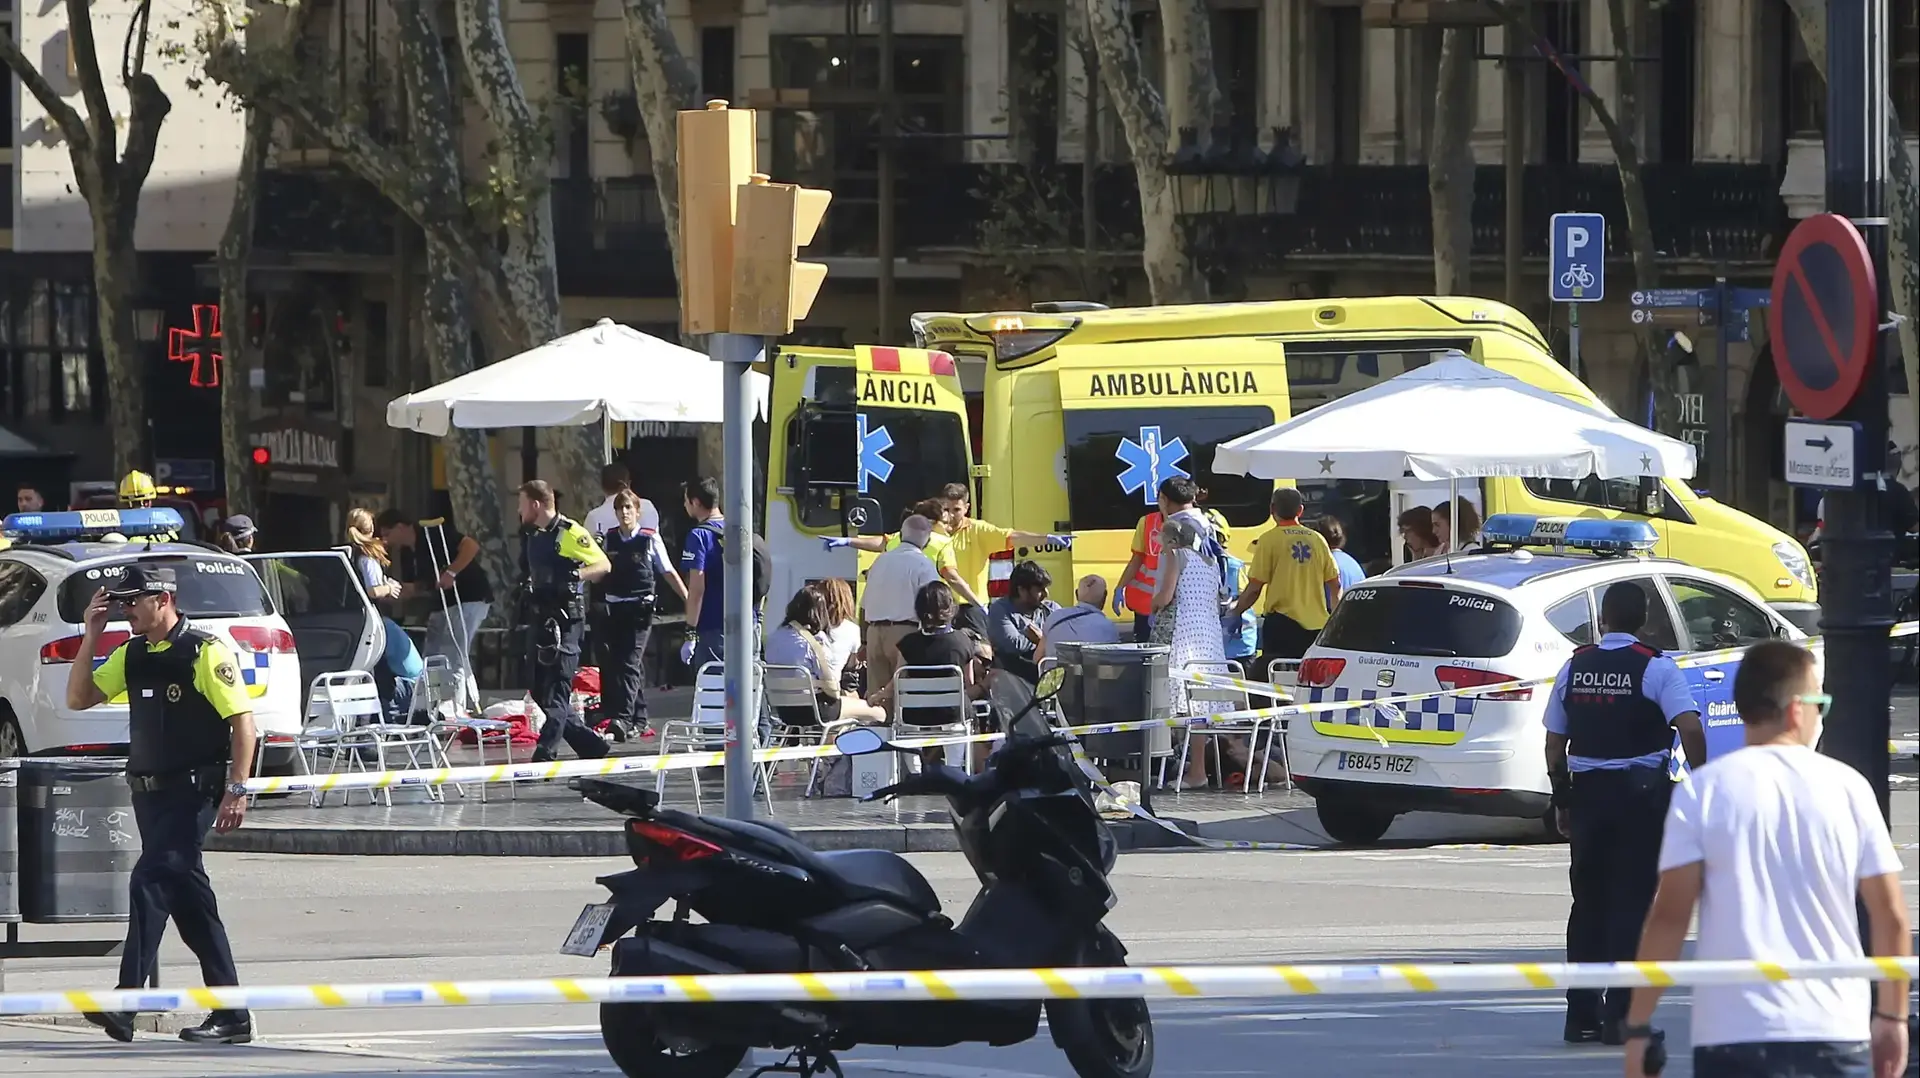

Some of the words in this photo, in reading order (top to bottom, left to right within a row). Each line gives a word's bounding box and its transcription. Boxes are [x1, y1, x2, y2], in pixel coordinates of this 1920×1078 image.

[1567, 227, 1589, 258] P
[856, 372, 936, 406] ÀNCIA
[1090, 366, 1258, 397] AMBULÀNCIA
[1674, 393, 1706, 424] OTEL
[85, 512, 116, 524] POLICIA
[1534, 522, 1564, 534] POLICIA
[196, 562, 245, 575] Policia
[1449, 595, 1495, 612] Policia
[1391, 657, 1420, 668] Urbana
[1451, 659, 1475, 668] C-711
[1573, 672, 1632, 688] POLICIA
[1708, 700, 1739, 717] Guàrd
[1347, 754, 1381, 771] 6845
[1386, 756, 1414, 773] HGZ
